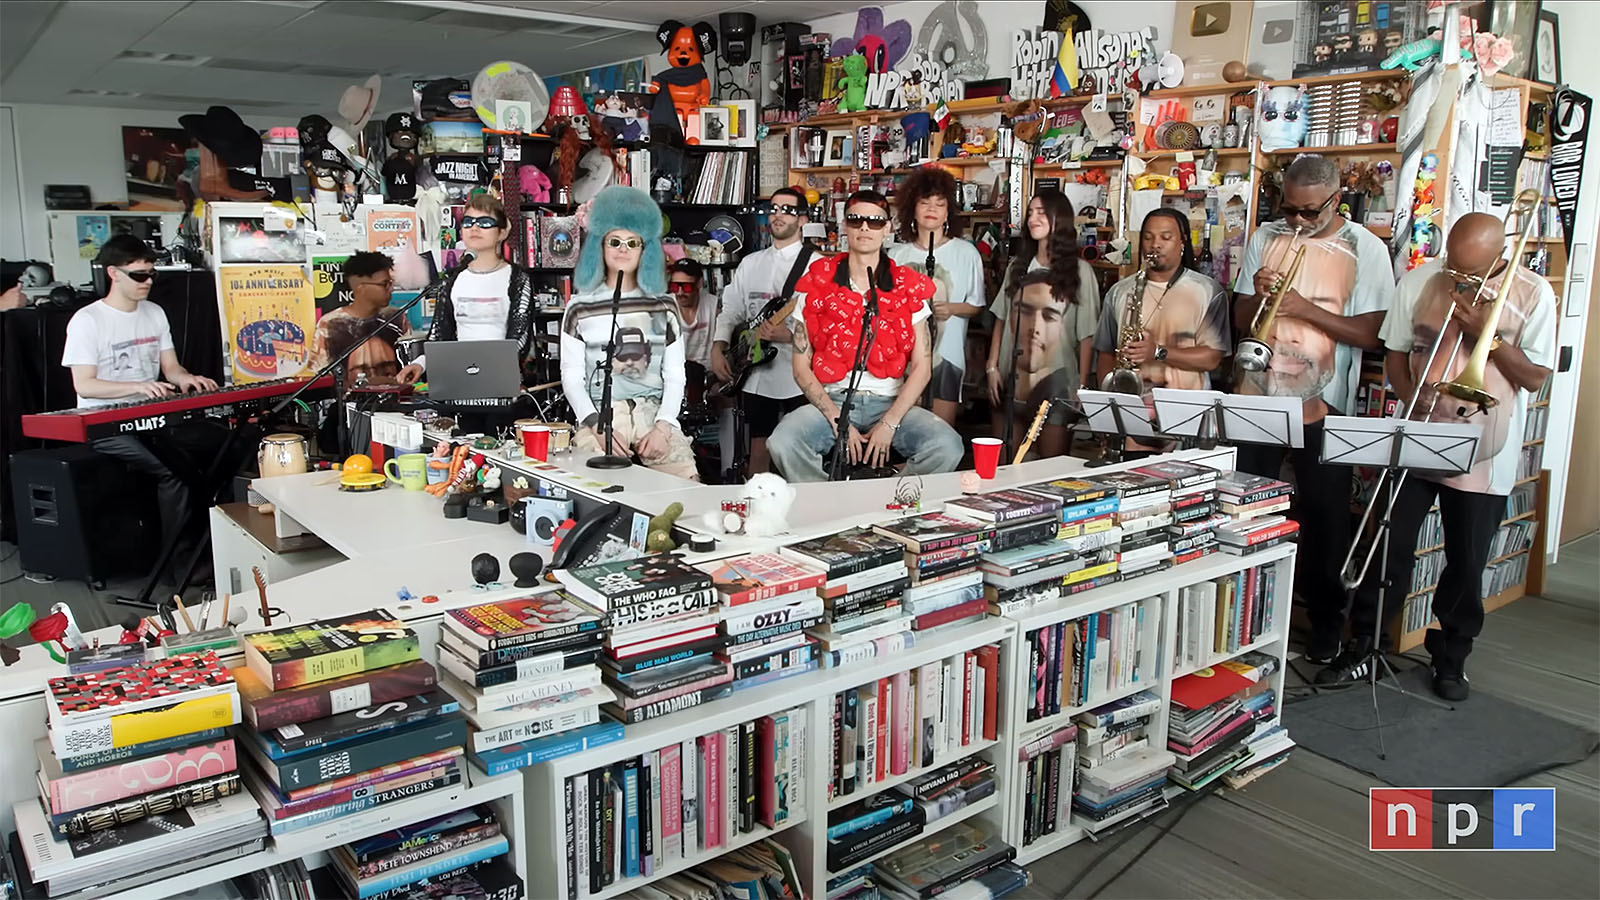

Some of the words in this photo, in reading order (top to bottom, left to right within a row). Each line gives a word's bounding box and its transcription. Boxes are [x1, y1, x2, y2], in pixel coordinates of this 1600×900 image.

[1011, 28, 1060, 69] Robin
[912, 53, 941, 83] Bob
[435, 162, 455, 174] JAZZ
[455, 161, 479, 174] NIGHT
[455, 173, 479, 181] AMERICA
[1551, 164, 1580, 200] LOVED
[1558, 199, 1576, 211] IT
[373, 222, 412, 231] CONTEST
[264, 269, 284, 277] MUSIC
[244, 278, 305, 290] ANNIVERSARY
[812, 299, 824, 310] Te
[1252, 492, 1270, 503] FRANK
[1005, 507, 1031, 520] COUNTRY
[1068, 510, 1087, 519] DYLAN
[1087, 506, 1095, 514] ON
[1095, 503, 1114, 513] DYLAN
[940, 540, 951, 548] WITH
[1251, 533, 1268, 543] TAYLOR
[1267, 530, 1281, 539] SWIFT
[614, 597, 631, 607] THE
[633, 591, 656, 603] WHO
[658, 587, 677, 597] FAQ
[682, 589, 719, 611] CALL
[740, 621, 751, 629] AM
[753, 608, 791, 629] OZZY
[737, 635, 746, 643] THE
[746, 633, 754, 641] DAY
[754, 627, 779, 640] ALTERNATIVE
[780, 625, 791, 634] MUSIC
[791, 622, 801, 631] DIED
[635, 660, 653, 670] BLUE
[654, 656, 670, 666] MAN
[670, 650, 694, 661] WORLD
[519, 663, 563, 679] HANDEL
[505, 681, 575, 705] McCARTNEY
[646, 691, 702, 719] ALTAMONT
[1121, 708, 1142, 718] DUKE
[92, 733, 98, 744] OF
[485, 734, 497, 744] THE
[498, 729, 514, 743] ART
[524, 719, 554, 736] NOISE
[70, 751, 101, 764] SONGS
[76, 757, 97, 769] AND
[97, 750, 133, 765] HORROR
[866, 757, 874, 776] There
[670, 760, 679, 822] SONGWRITERS
[918, 776, 946, 794] NIRVANA
[946, 769, 959, 783] FAQ
[368, 780, 435, 805] STRANGERS
[664, 766, 672, 828] SONGWRITING
[868, 834, 886, 846] HISTORY
[378, 857, 400, 872] PETE
[400, 841, 453, 864] TOWNSHEND
[419, 855, 470, 877] HENDRIX
[451, 867, 468, 877] REED
